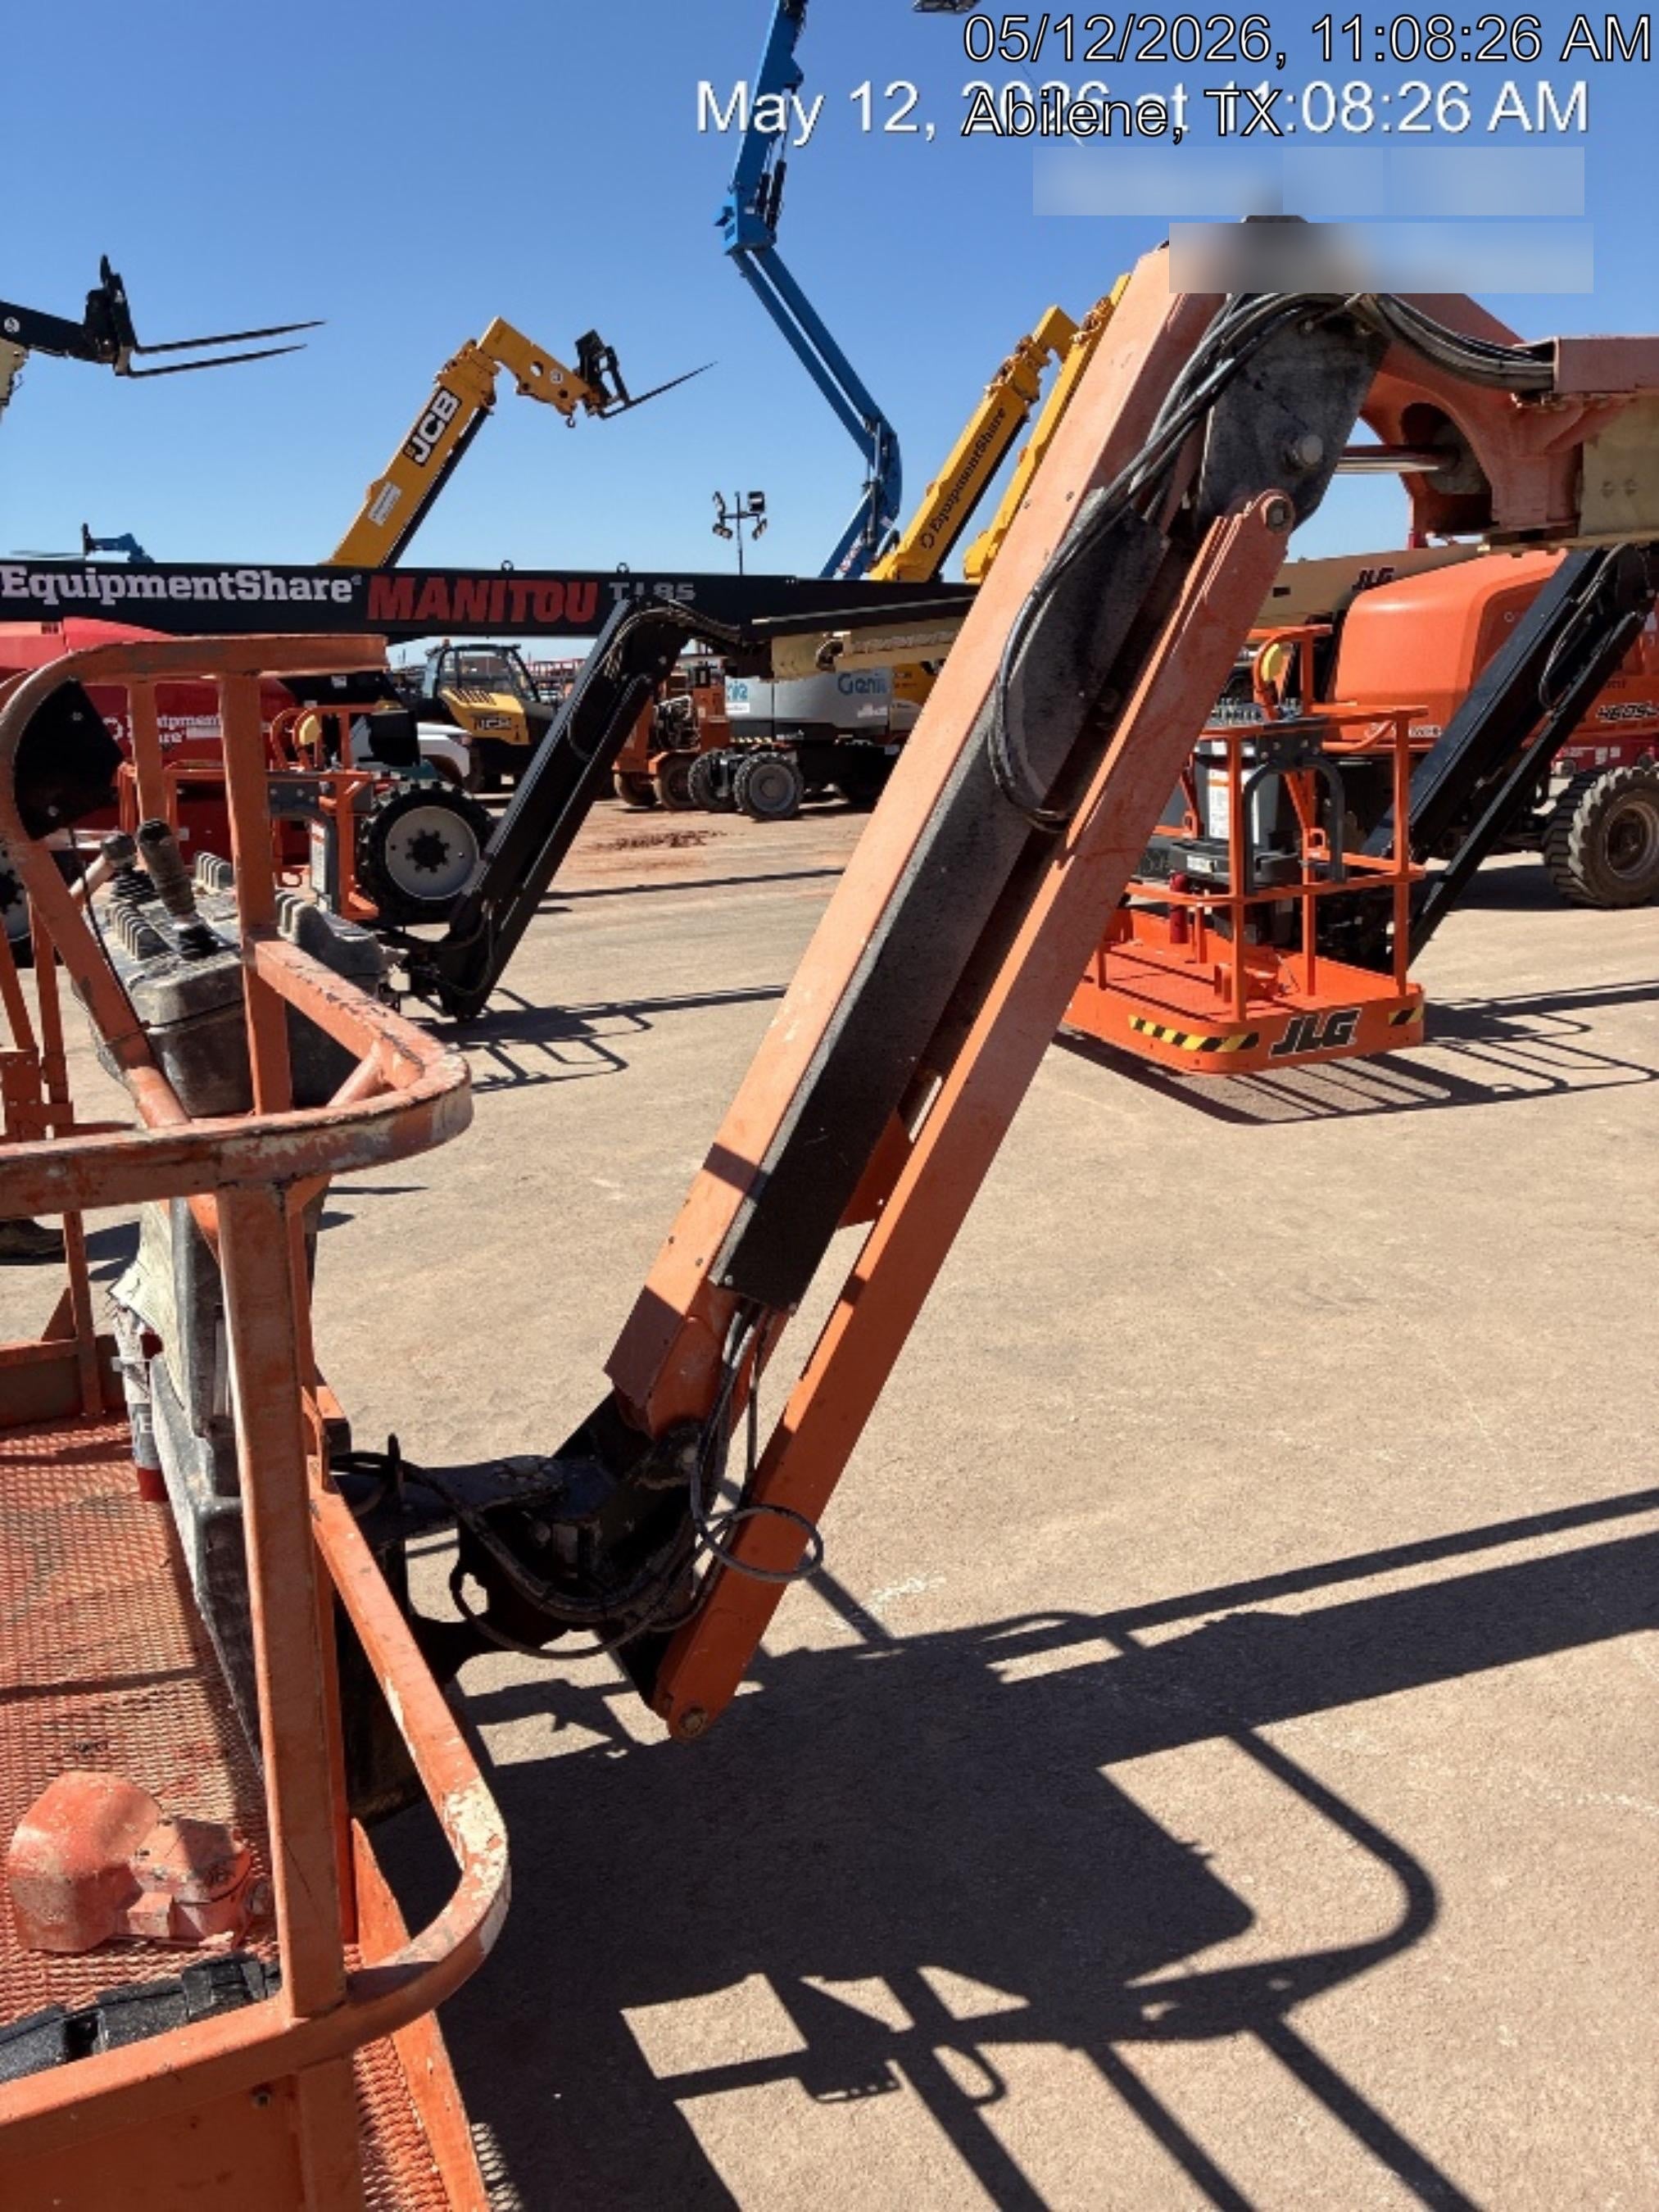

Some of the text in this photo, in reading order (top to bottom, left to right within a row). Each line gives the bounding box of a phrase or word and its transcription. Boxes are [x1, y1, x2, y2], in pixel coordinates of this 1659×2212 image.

[405, 388, 461, 465] JCB
[929, 407, 1007, 534] EquipmentShare
[1, 565, 354, 605] EquipmentShare
[366, 575, 598, 623] MANITOU
[1269, 1008, 1362, 1059] JLG
